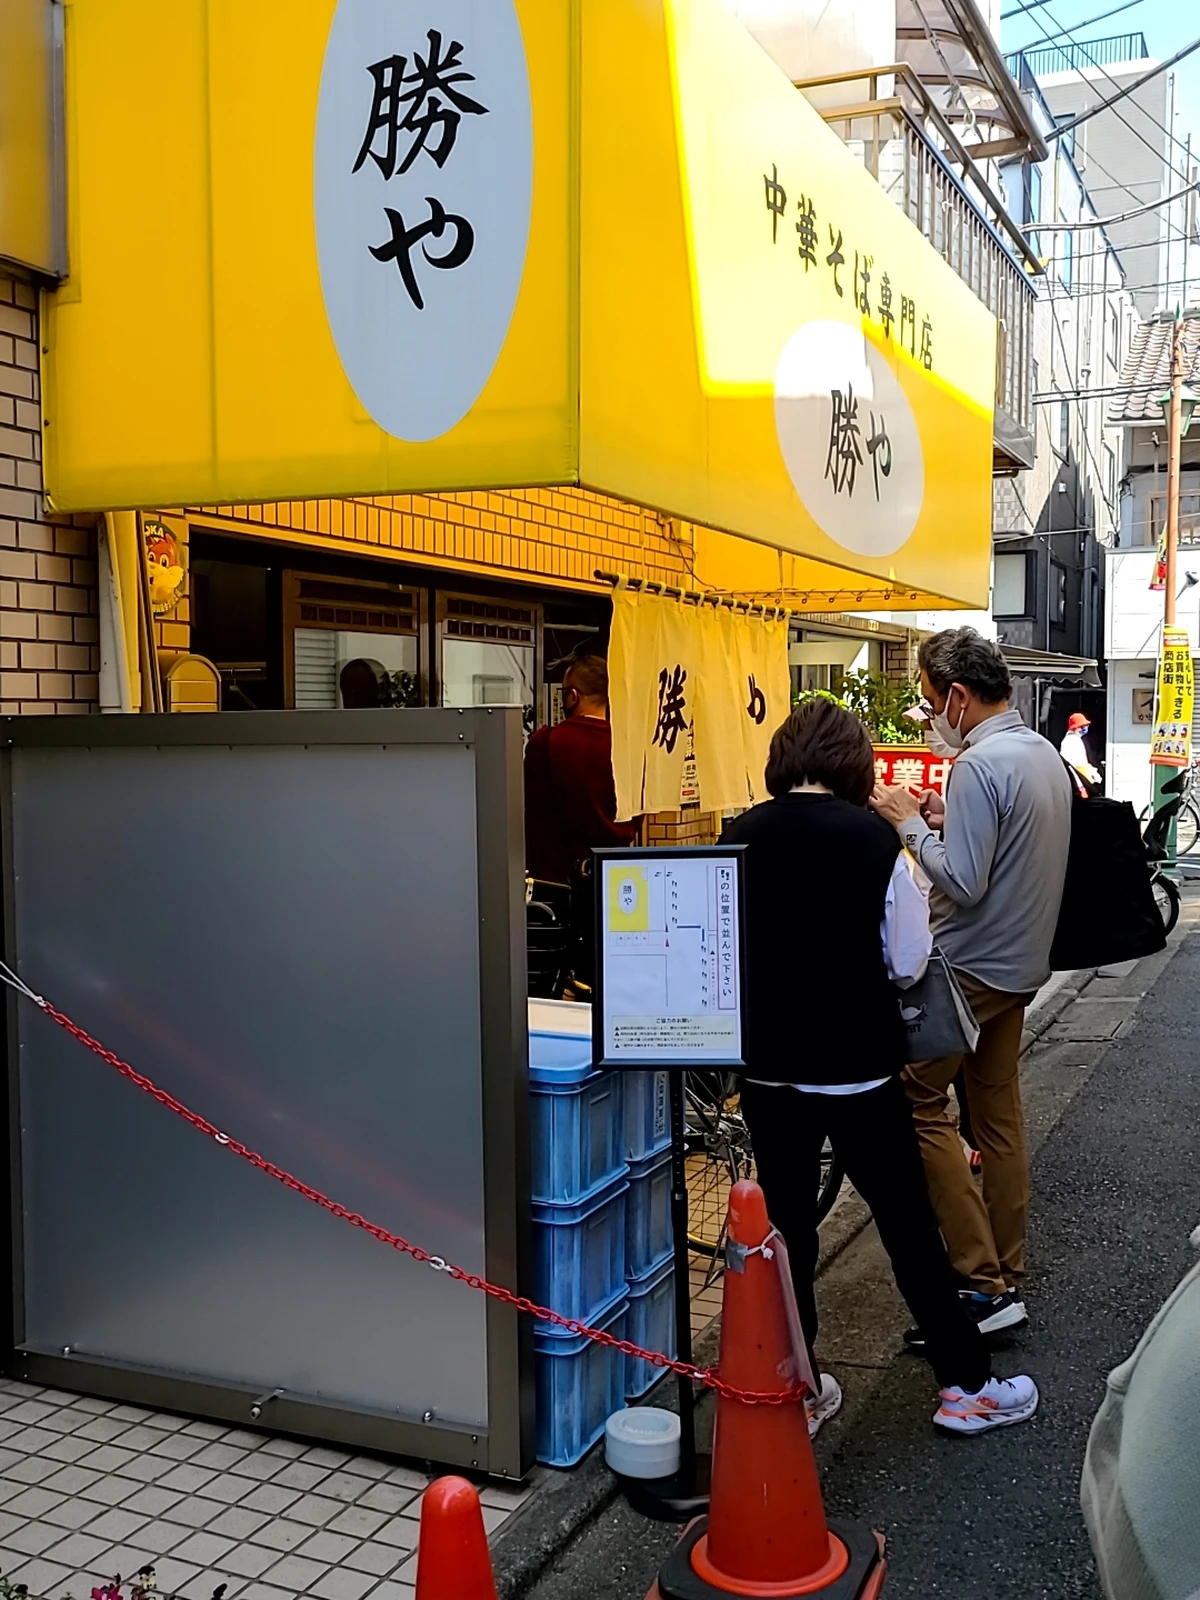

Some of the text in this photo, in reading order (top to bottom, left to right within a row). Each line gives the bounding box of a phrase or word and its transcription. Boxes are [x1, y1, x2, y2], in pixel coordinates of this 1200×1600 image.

[351, 28, 490, 311] 勝や
[763, 162, 934, 372] 中華そば専門店
[824, 381, 893, 502] 勝や
[1163, 650, 1174, 685] 商店街
[1173, 650, 1184, 720] お買物できる
[720, 882, 732, 997] の位置で並んで下さい
